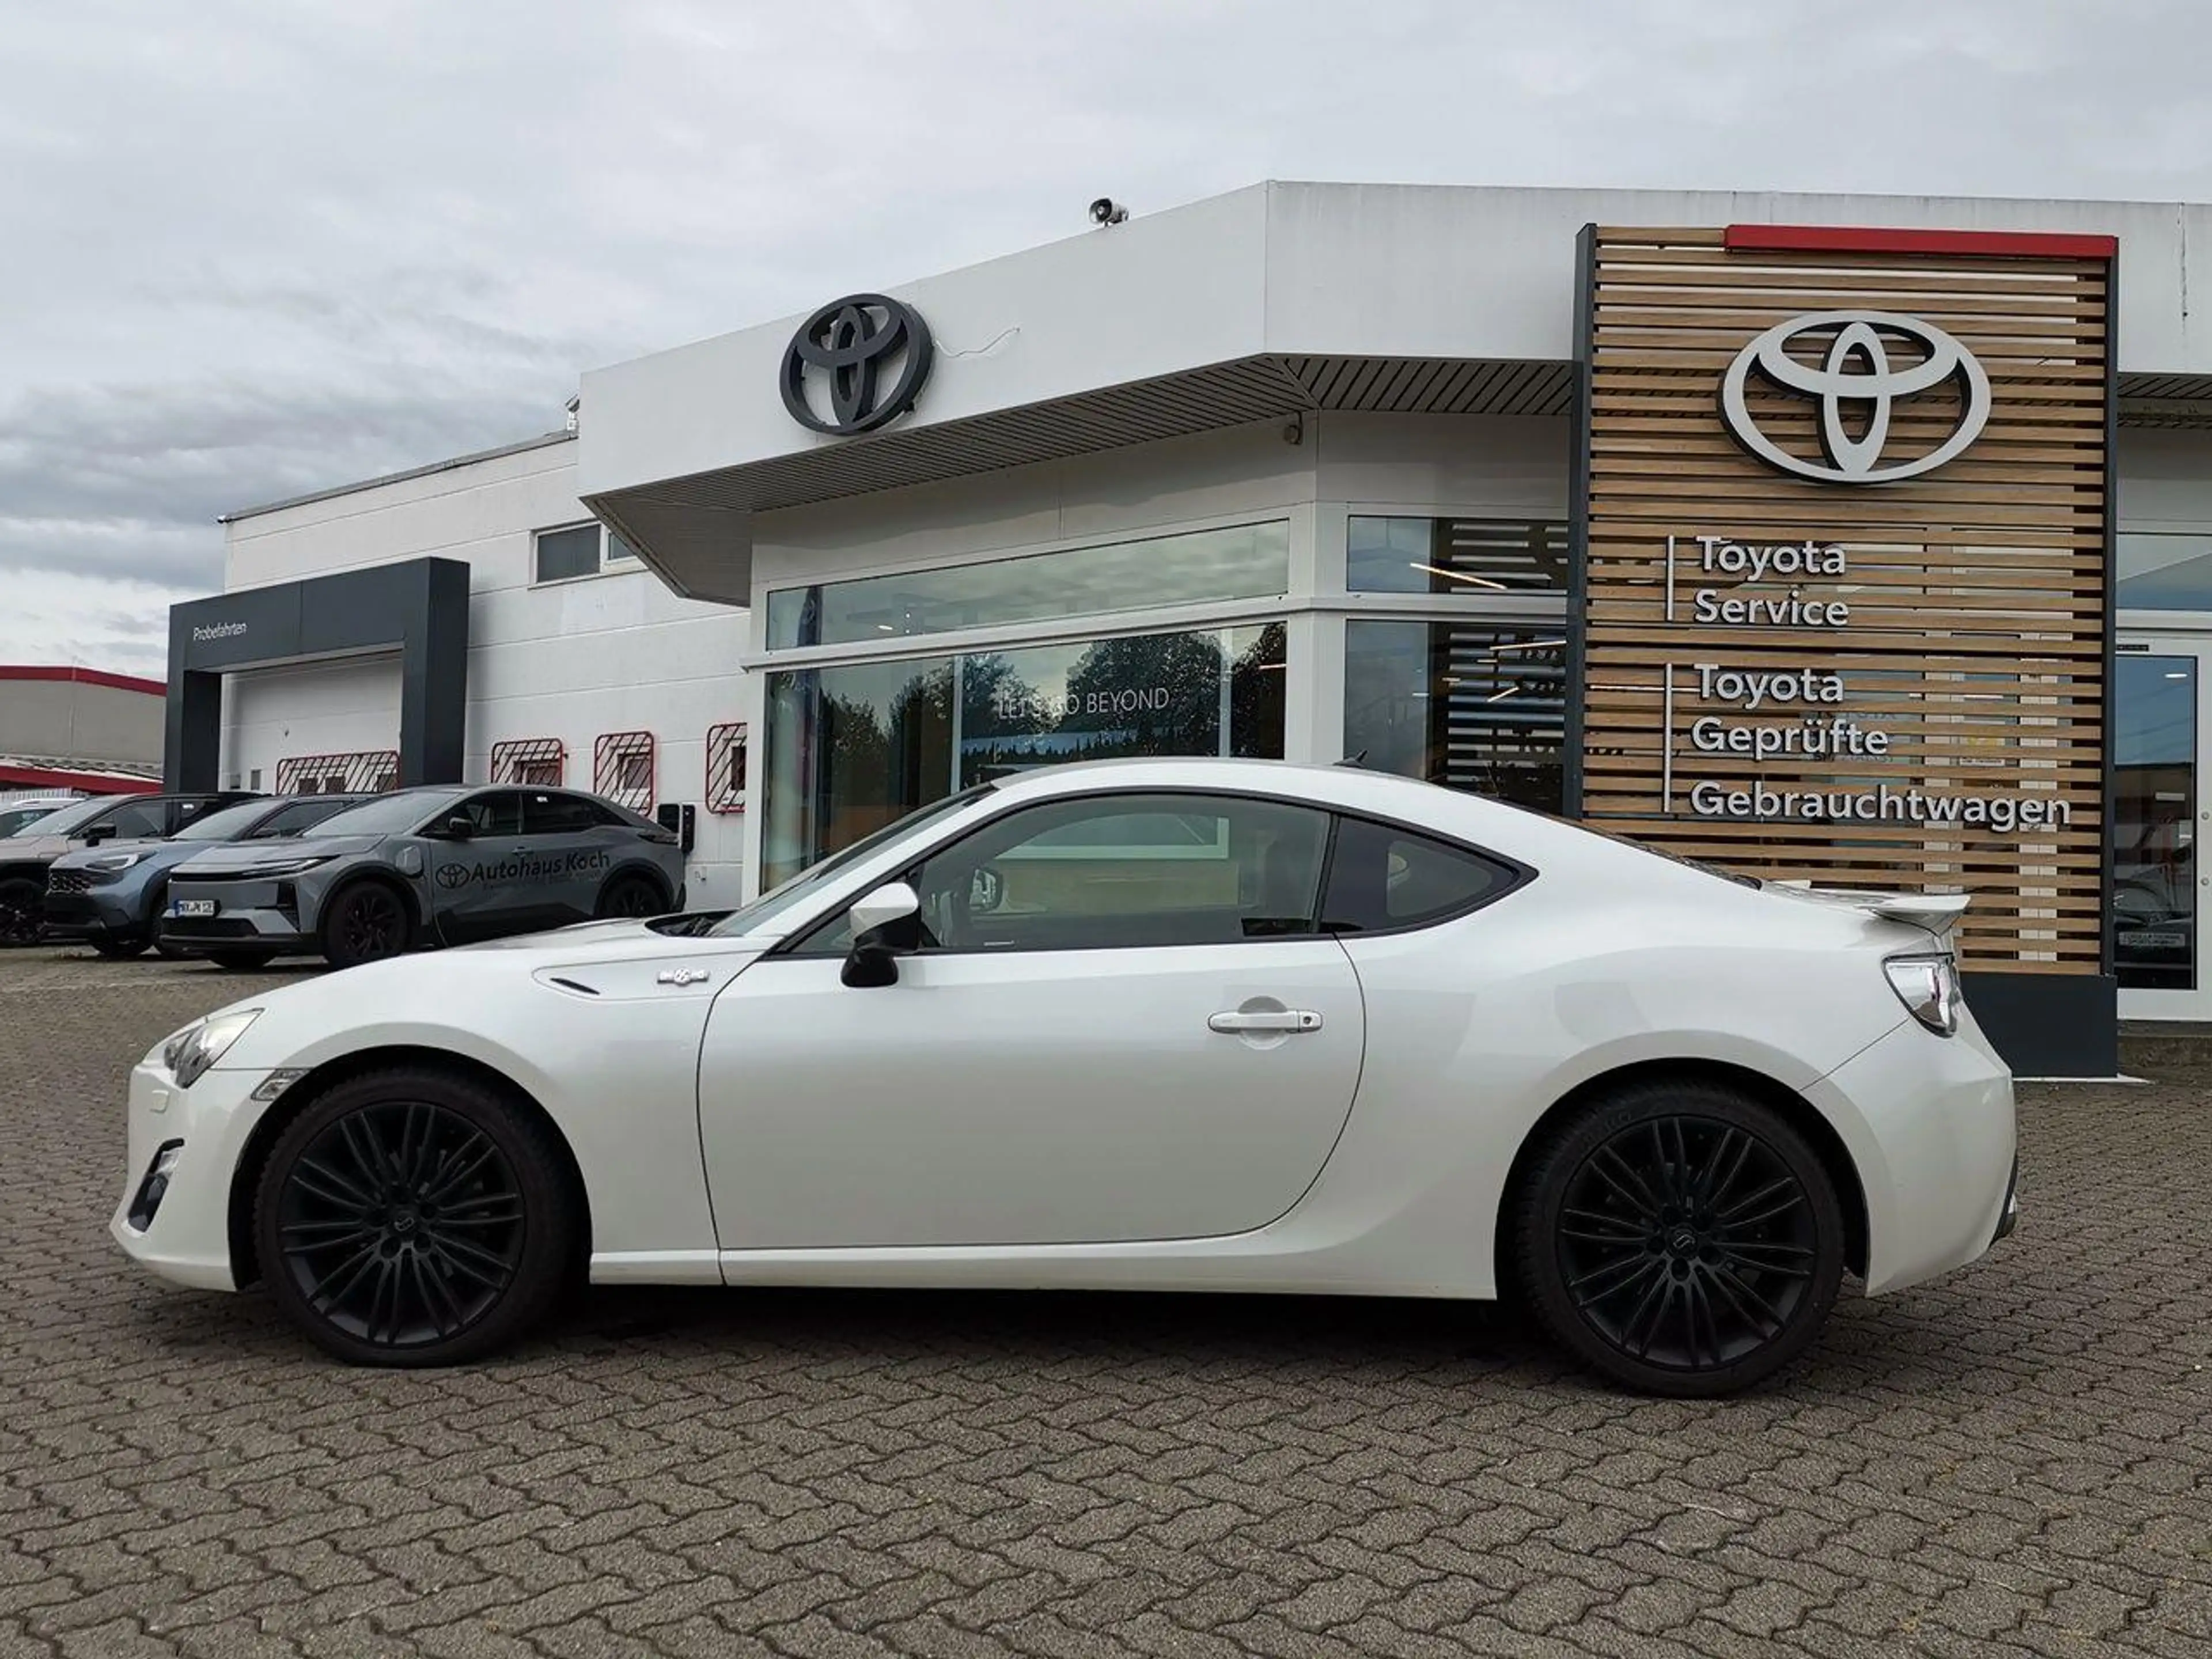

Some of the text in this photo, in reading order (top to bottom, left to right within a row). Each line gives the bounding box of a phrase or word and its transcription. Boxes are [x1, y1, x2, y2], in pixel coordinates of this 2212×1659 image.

[1695, 535, 1846, 582] Toyota
[1694, 589, 1850, 626] Service
[193, 622, 247, 641] Probefahrten
[1086, 687, 1169, 714] BEYOND
[1692, 662, 1844, 709] Toyota
[1691, 717, 1888, 762] Geprüfte
[1690, 781, 2071, 832] Gebrauchtwagen
[470, 857, 562, 882] Autohaus
[566, 850, 611, 872] Koch
